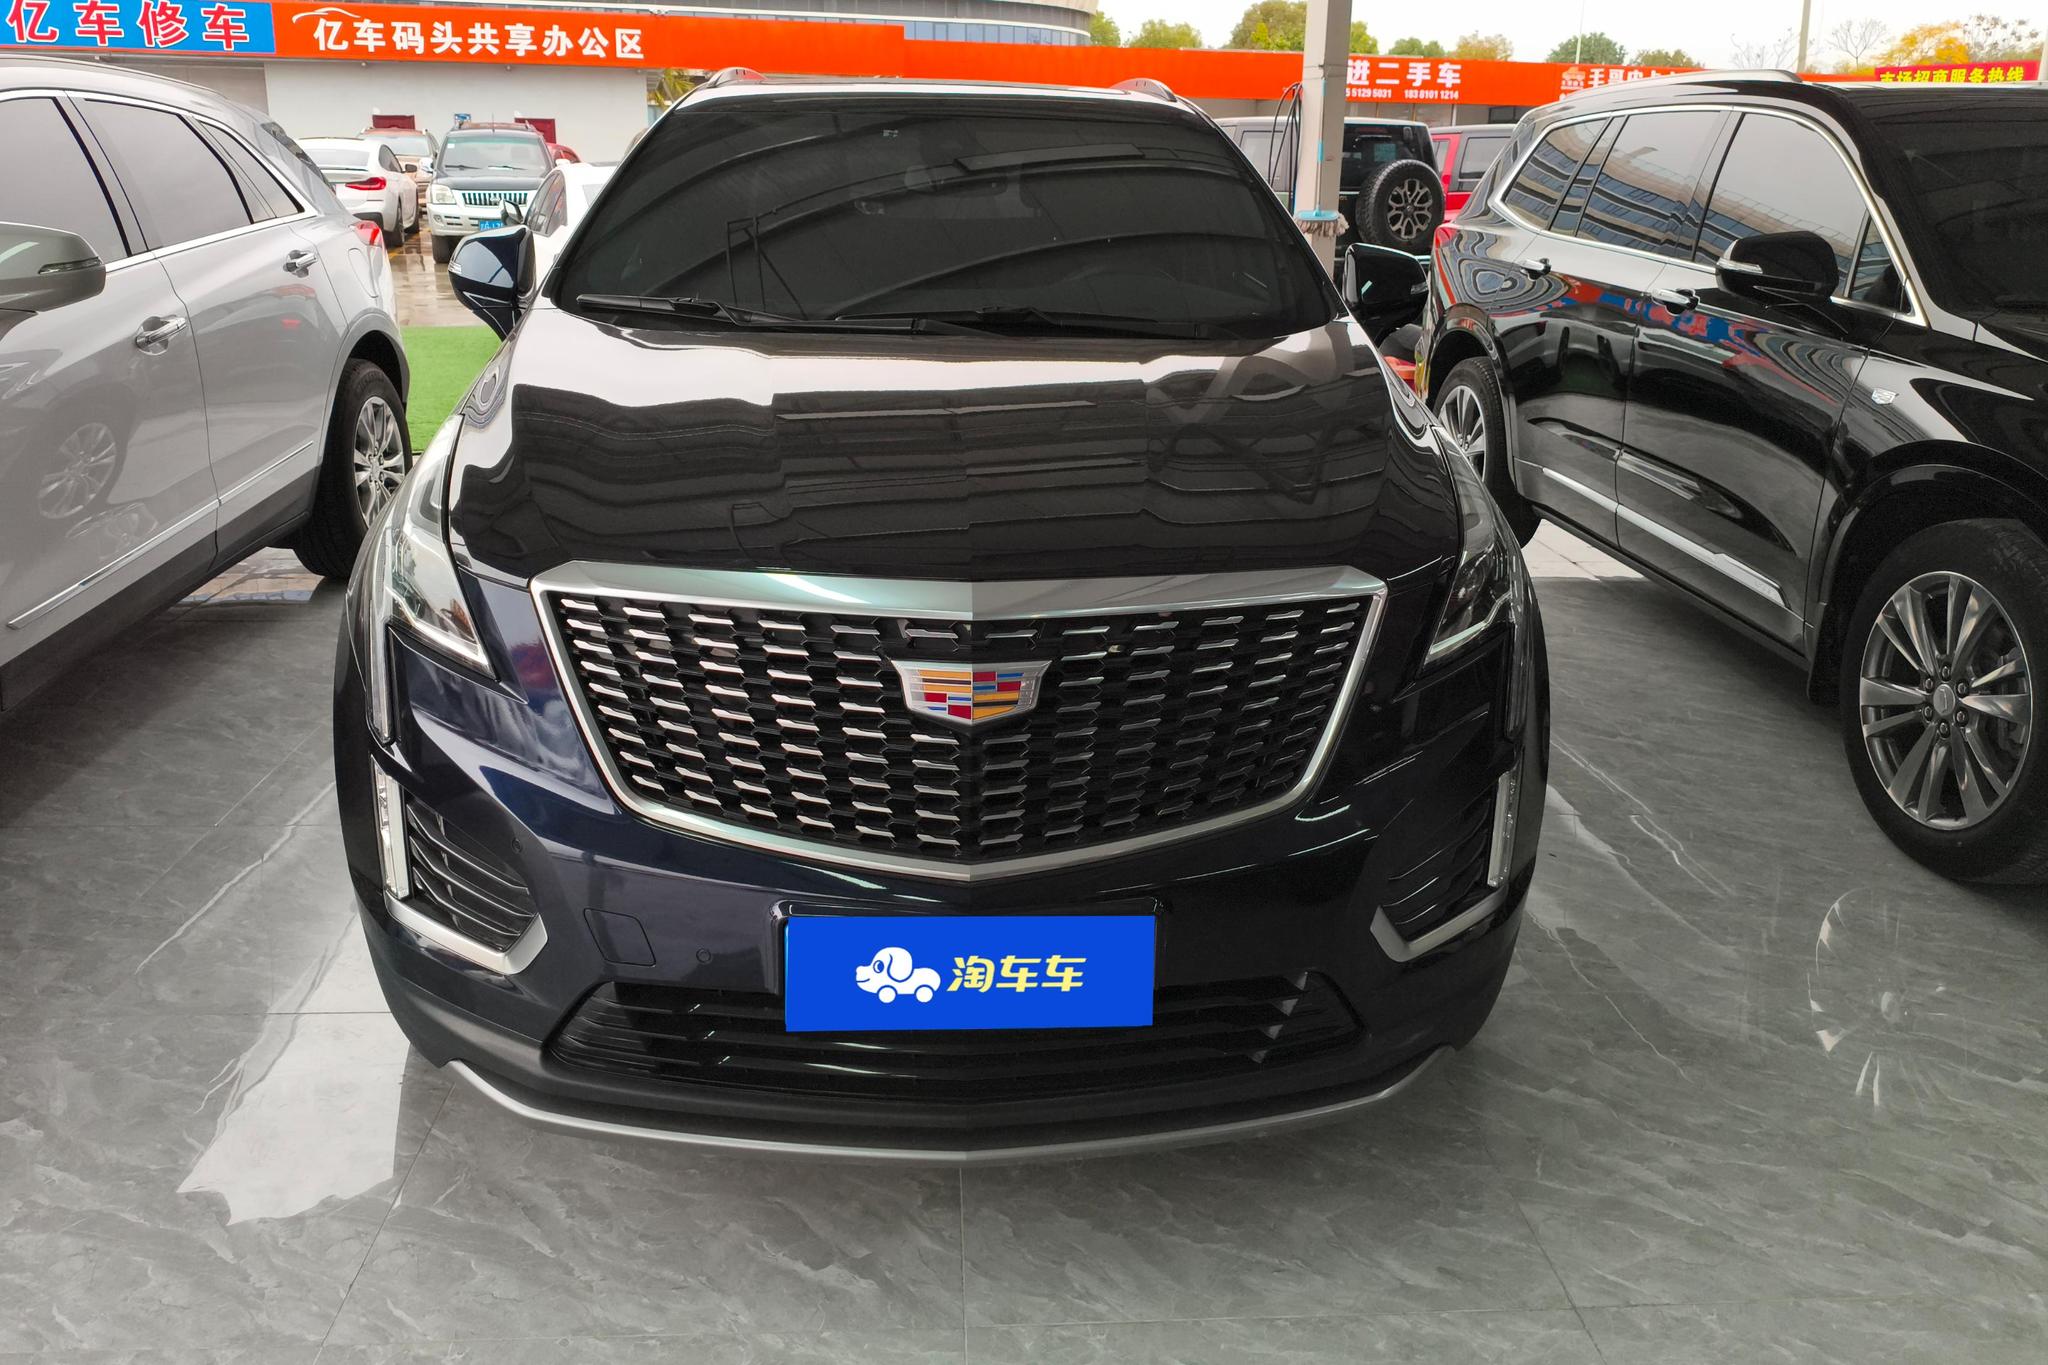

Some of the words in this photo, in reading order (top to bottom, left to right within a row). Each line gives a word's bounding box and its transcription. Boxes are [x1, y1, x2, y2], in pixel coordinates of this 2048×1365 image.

[6, 0, 250, 51] 亿车修车
[314, 18, 645, 59] 亿车码头共享办公区
